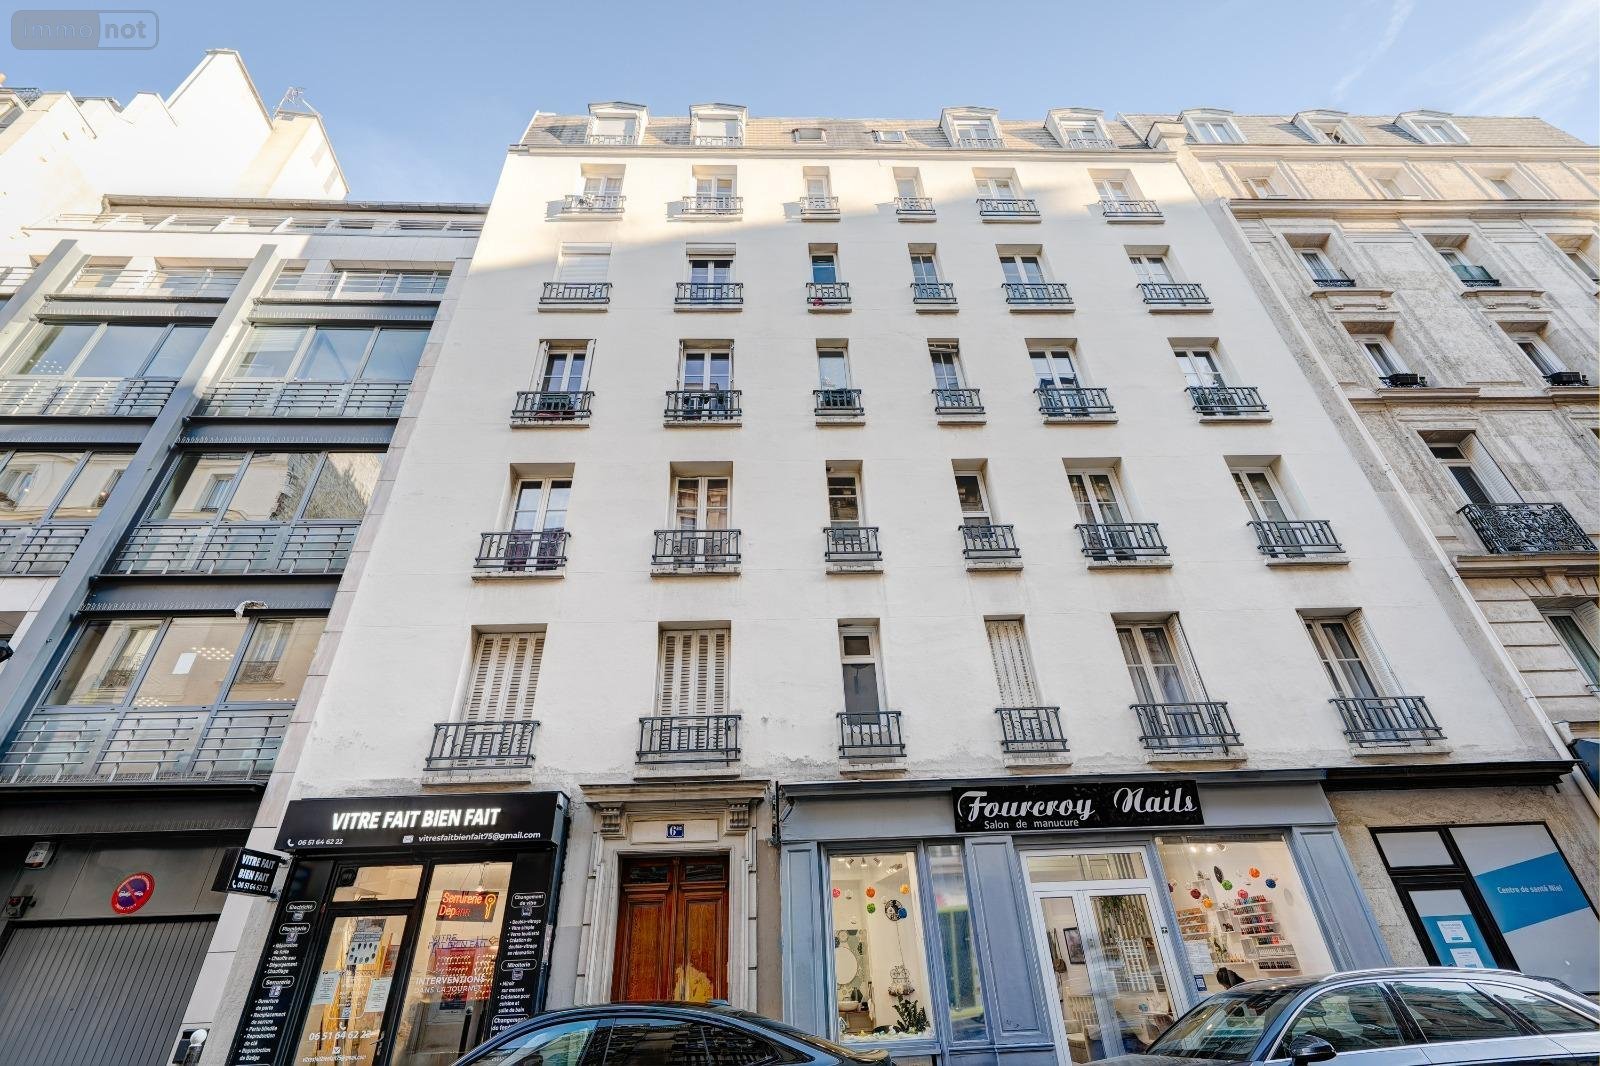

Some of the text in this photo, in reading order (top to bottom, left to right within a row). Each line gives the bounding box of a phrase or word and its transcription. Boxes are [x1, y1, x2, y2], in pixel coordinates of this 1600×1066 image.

[957, 787, 1198, 822] Fourcroy Nails
[332, 807, 501, 831] VITRE FAIT BIEN FAIT
[984, 818, 1080, 830] Salon de manucure
[418, 831, 541, 843] vitresfaitbienfait75@gmail.com
[241, 854, 276, 870] VITRE FAIT
[238, 868, 270, 883] BIEN FAIT
[1497, 886, 1520, 894] Centre
[1520, 885, 1530, 893] de
[442, 892, 483, 905] Serrurerie
[416, 975, 486, 985] INTERVENTIONS
[347, 1030, 360, 1039] 62
